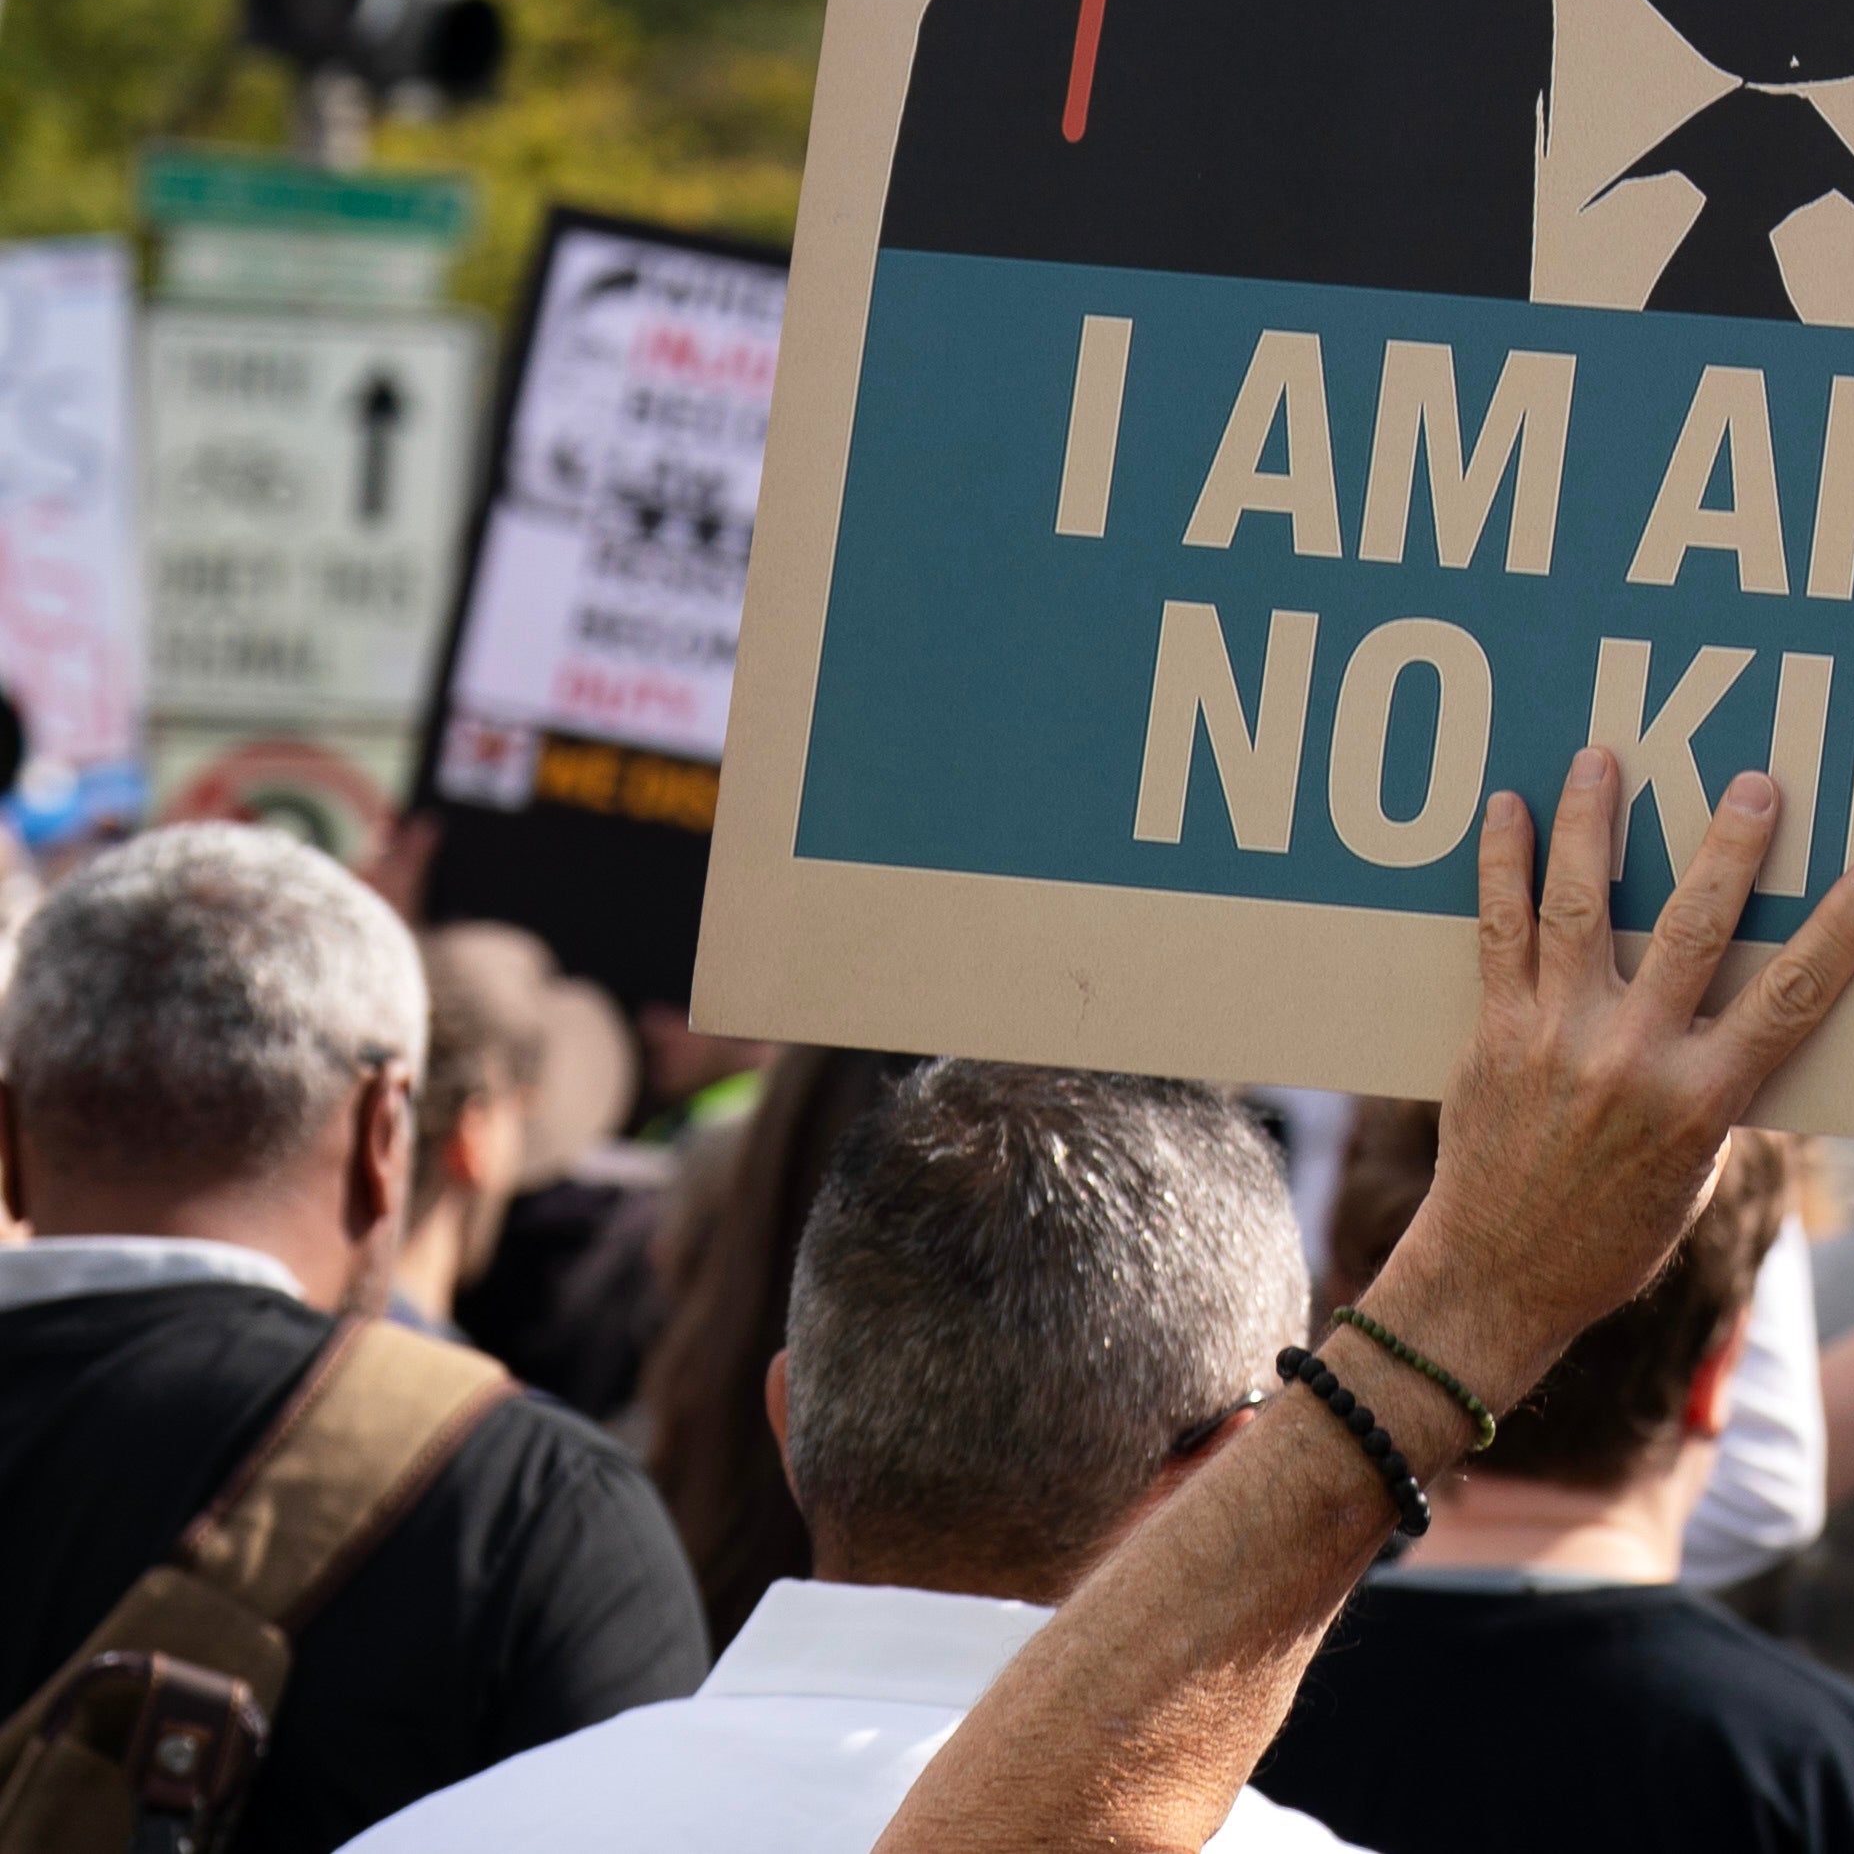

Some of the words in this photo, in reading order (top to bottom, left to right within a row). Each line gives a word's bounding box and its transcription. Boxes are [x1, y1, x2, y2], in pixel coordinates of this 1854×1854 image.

[1055, 316, 1133, 538] I
[1183, 331, 1577, 576] AM
[1134, 601, 1493, 868] NO
